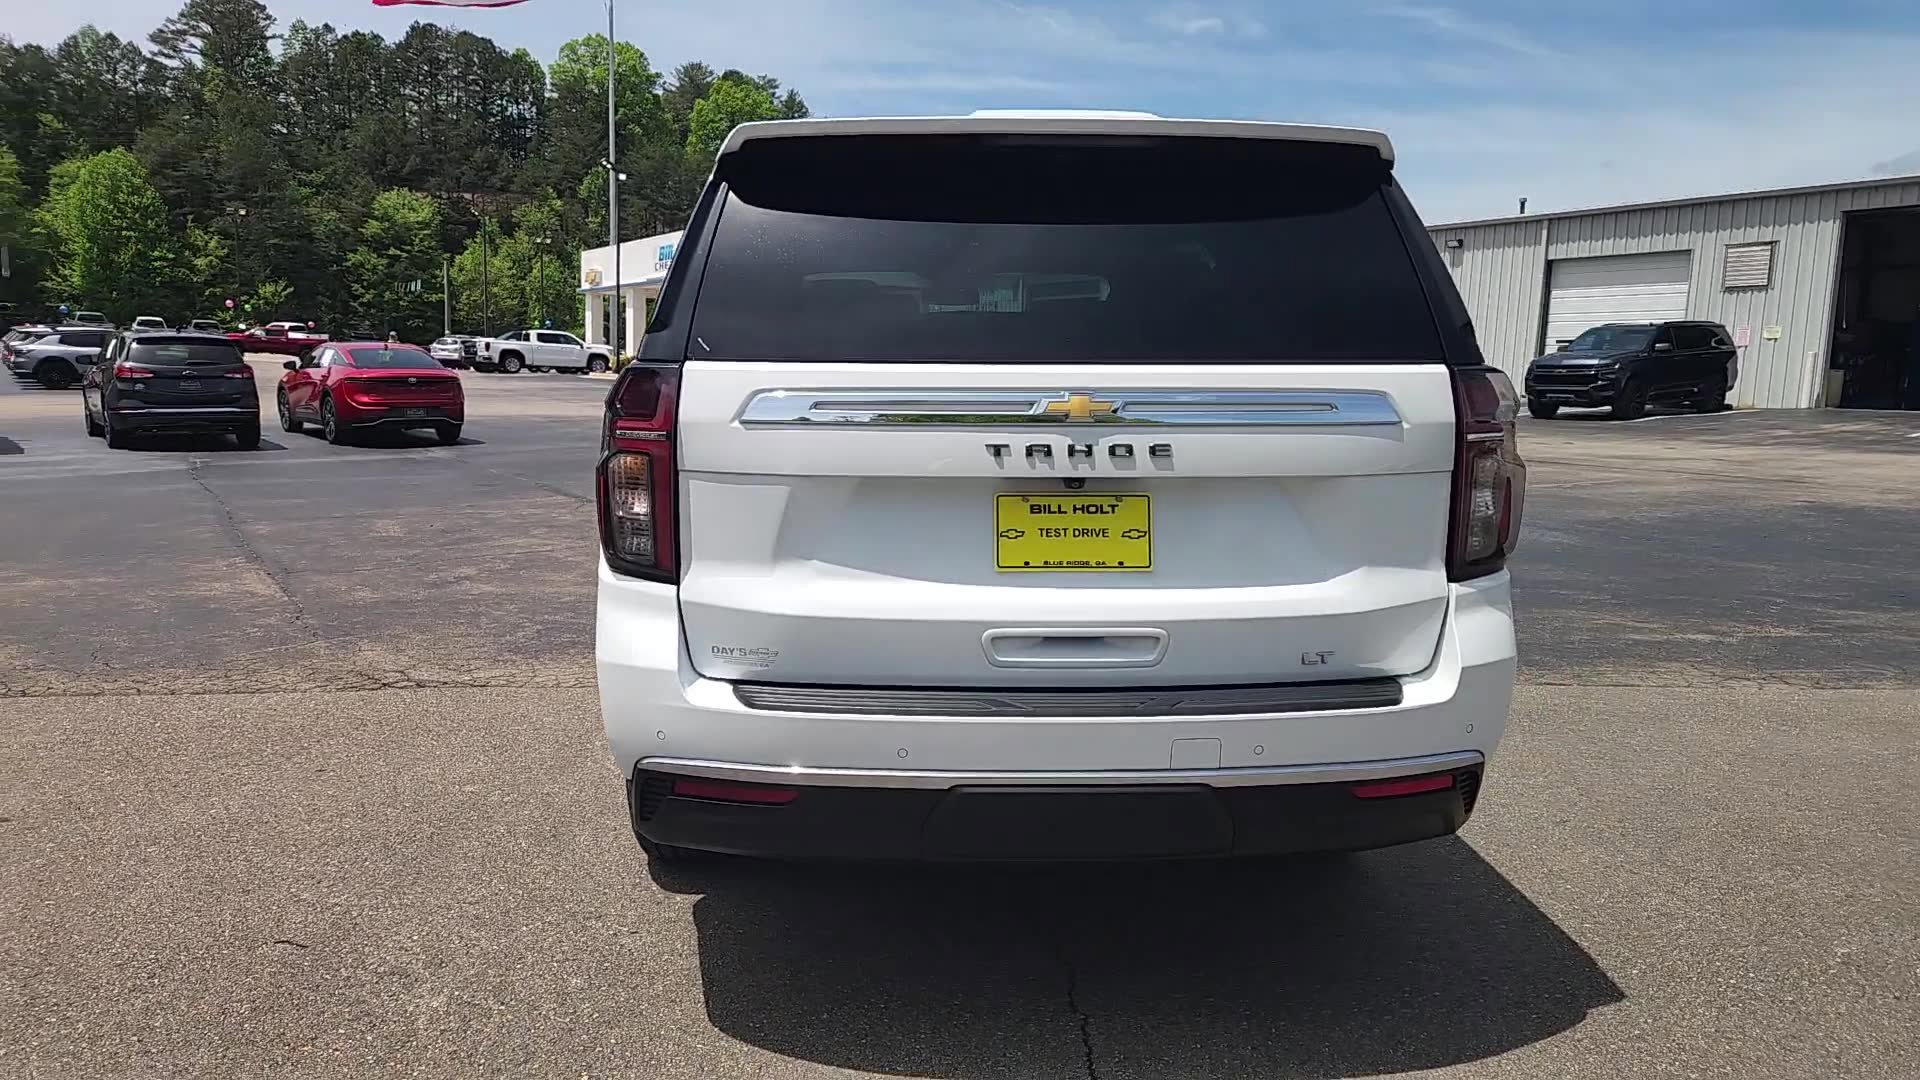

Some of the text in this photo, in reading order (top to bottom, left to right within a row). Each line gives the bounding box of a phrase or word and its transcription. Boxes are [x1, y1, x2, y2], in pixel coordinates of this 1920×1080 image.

[985, 443, 1173, 459] TAHOE
[1029, 504, 1119, 514] BILL HOLT
[1038, 528, 1109, 538] TEST DRIVE
[711, 645, 748, 657] DAY'S
[1301, 650, 1336, 666] LT
